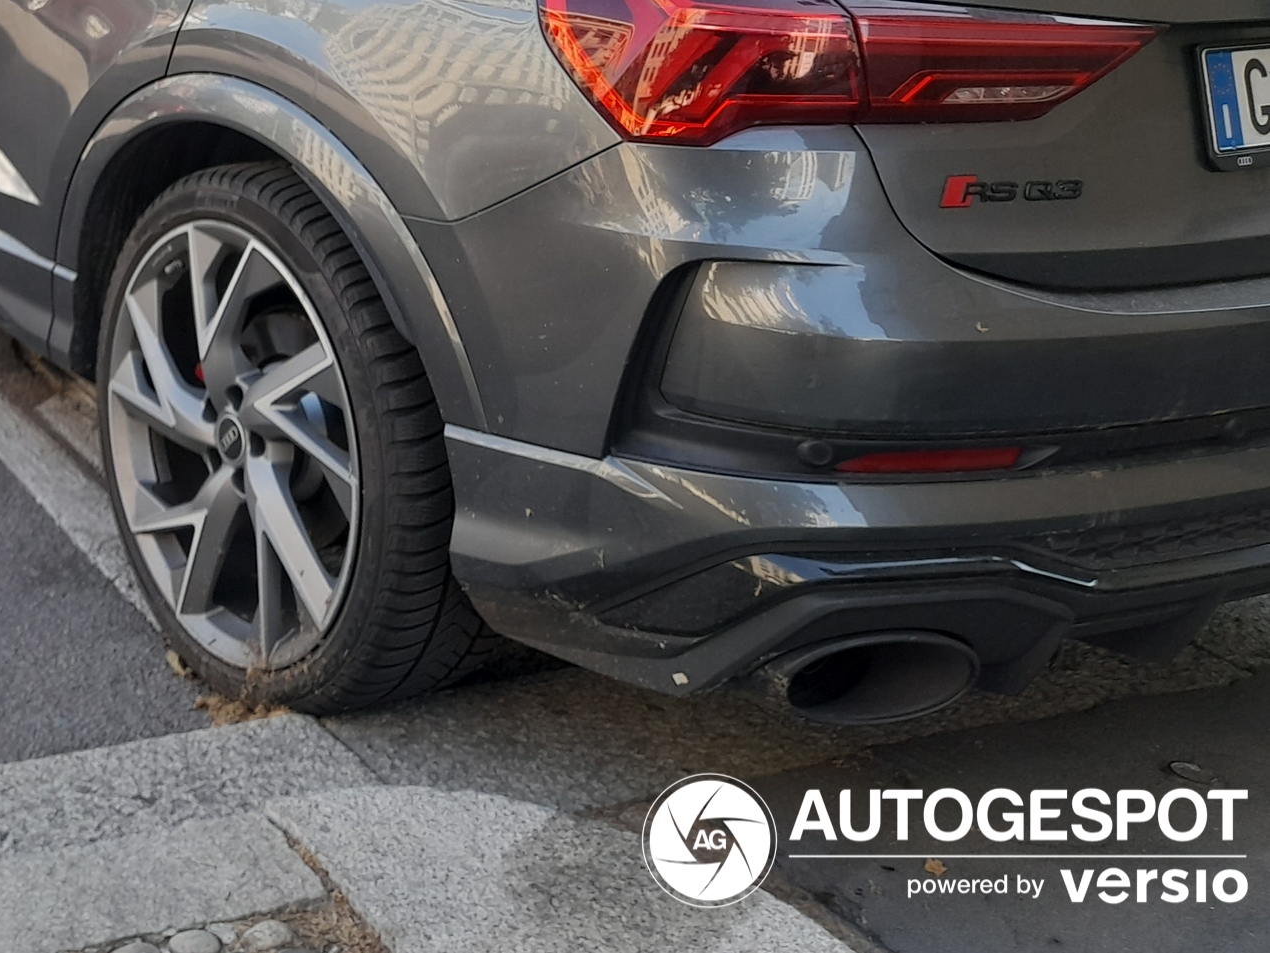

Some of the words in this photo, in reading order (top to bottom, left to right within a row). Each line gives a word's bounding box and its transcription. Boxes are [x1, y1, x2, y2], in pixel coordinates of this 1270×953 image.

[1222, 104, 1233, 138] I
[959, 180, 1019, 203] RS
[1023, 178, 1083, 202] Q3
